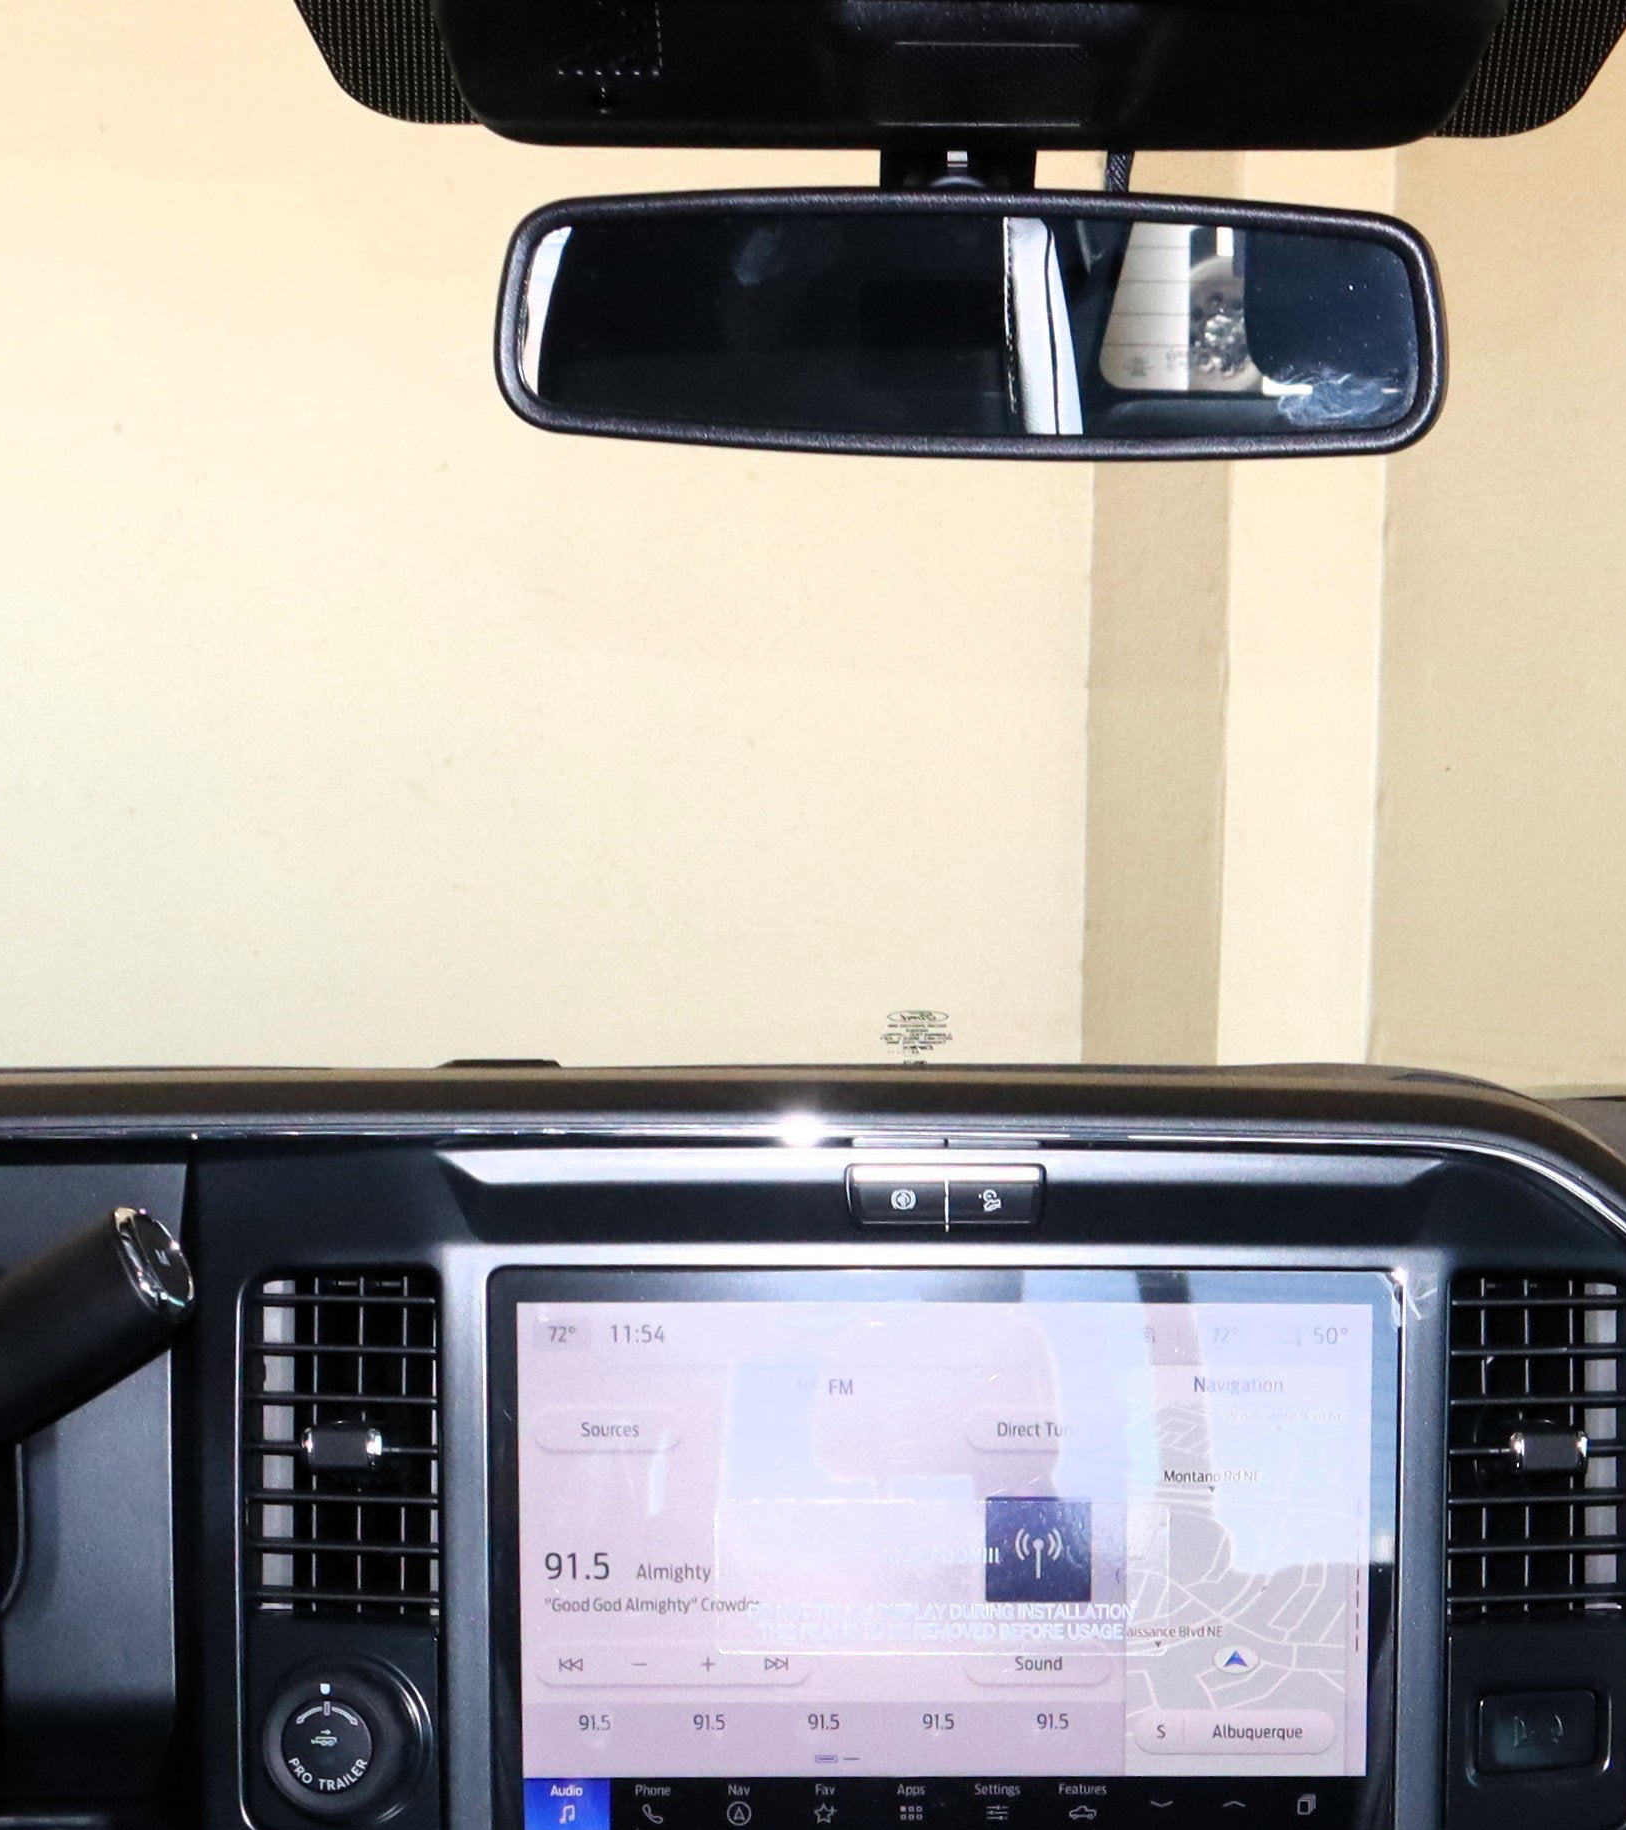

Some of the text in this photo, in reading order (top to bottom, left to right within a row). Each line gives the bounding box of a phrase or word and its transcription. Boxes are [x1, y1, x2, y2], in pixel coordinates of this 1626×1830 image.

[609, 1325, 666, 1343] 11:54
[828, 1379, 854, 1395] FM
[1193, 1375, 1284, 1396] Navigation
[581, 1422, 640, 1438] Sources
[997, 1422, 1040, 1438] Direct
[1163, 1470, 1220, 1483] Montano
[544, 1552, 611, 1581] 91.5
[636, 1564, 712, 1583] Almighty
[545, 1598, 590, 1612] "Good
[593, 1598, 622, 1612] God
[625, 1598, 697, 1615] Almighty"
[1018, 1603, 1135, 1620] INSTALLATION
[998, 1622, 1064, 1640] BEFORE
[1067, 1622, 1124, 1640] USAGE
[1179, 1625, 1204, 1637] Blvd
[1207, 1626, 1223, 1637] NE
[1015, 1656, 1063, 1671] Sound
[578, 1714, 612, 1731] 91.5
[693, 1713, 726, 1731] 91.5
[807, 1713, 841, 1730] 91.5
[922, 1713, 955, 1730] 91.5
[1036, 1713, 1069, 1730] 91.5
[1156, 1725, 1167, 1739] S
[1212, 1725, 1304, 1741] Albuquerque
[288, 1757, 368, 1791] PRO TRAILER
[550, 1784, 584, 1797] Audio
[634, 1784, 671, 1797] Phone
[727, 1784, 751, 1796] Nav
[814, 1784, 835, 1796] Fav
[896, 1783, 926, 1798] Apps
[974, 1783, 1021, 1798] Settings
[1058, 1783, 1107, 1796] Features
